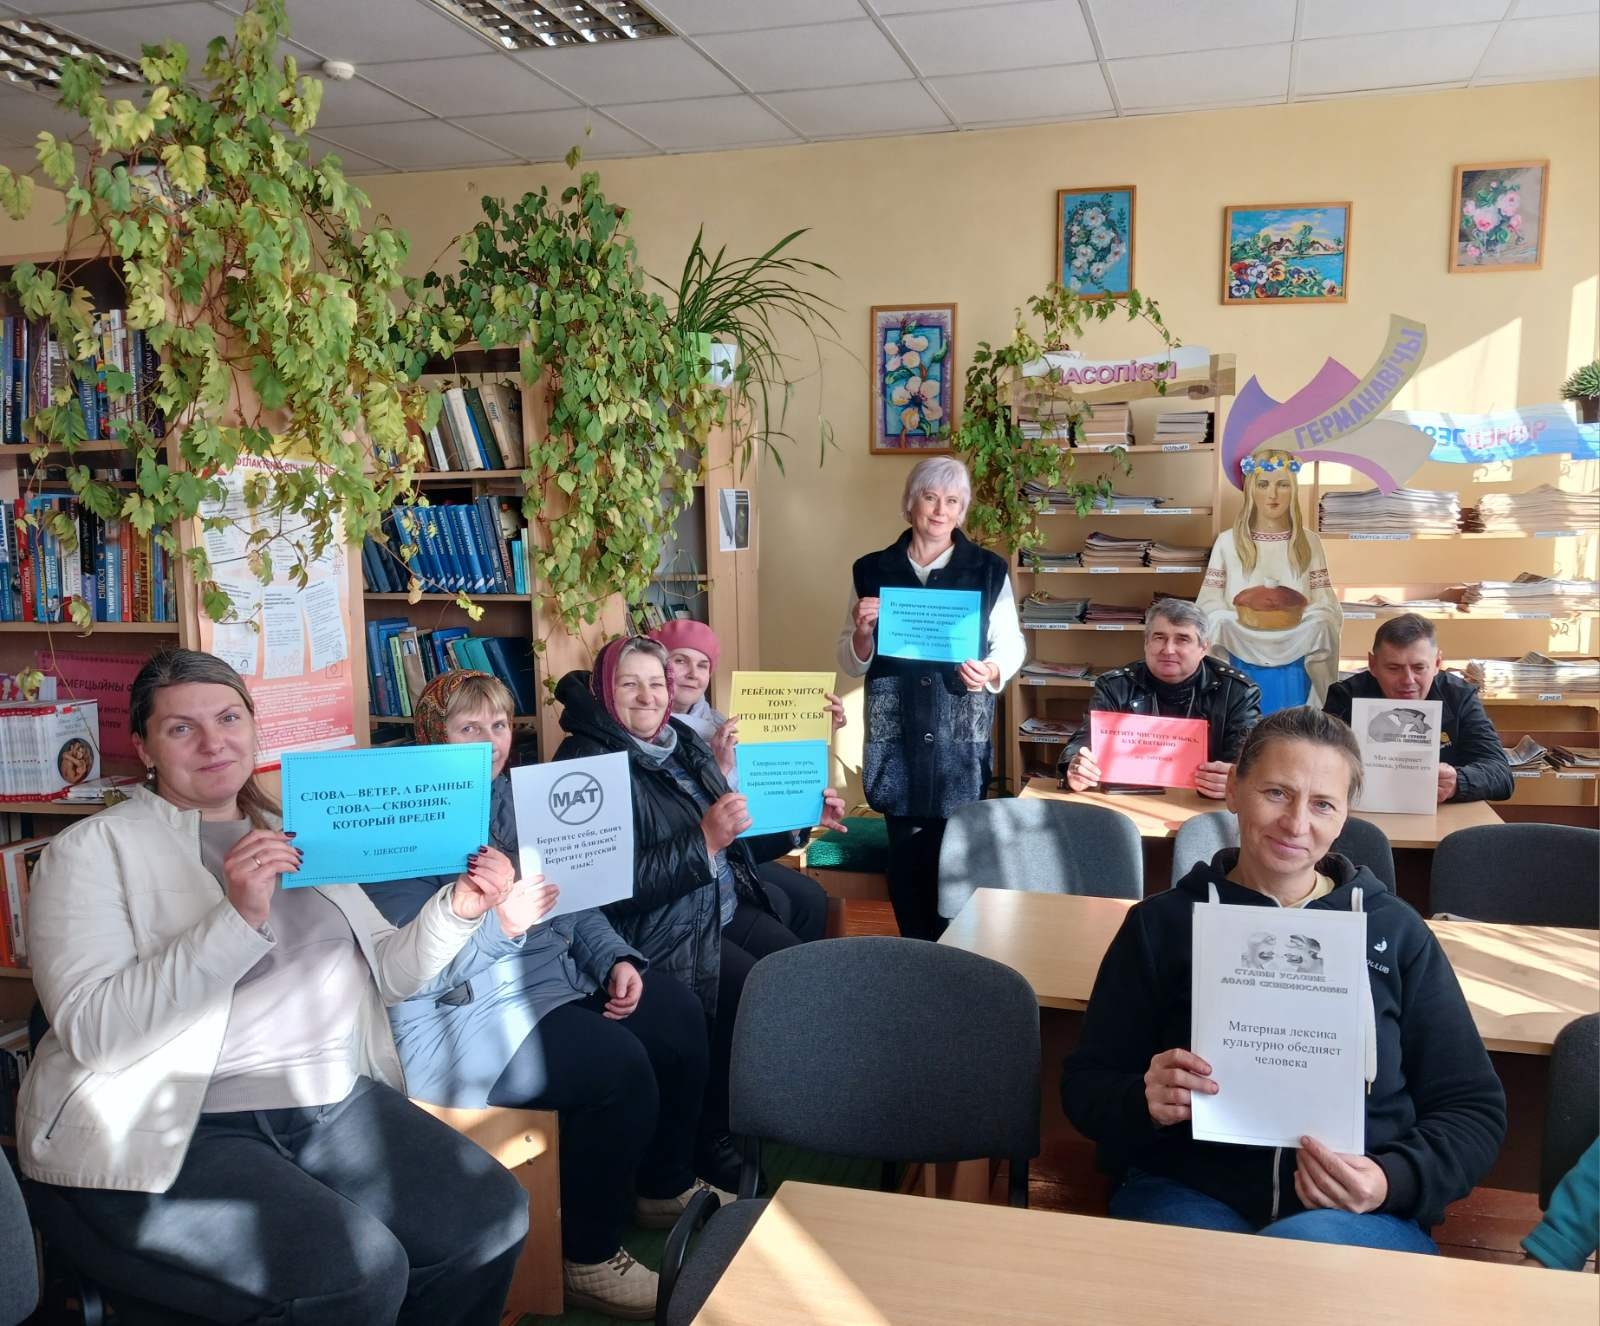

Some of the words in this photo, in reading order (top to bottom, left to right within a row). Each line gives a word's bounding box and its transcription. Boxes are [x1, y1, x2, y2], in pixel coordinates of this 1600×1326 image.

[1294, 327, 1425, 449] ГЕРМАНАВІЧЫ
[57, 679, 124, 692] АМЕРЦЫЙНЫ
[741, 686, 784, 696] РЕБЁНОК
[787, 687, 824, 696] УЧИТСЯ
[758, 712, 788, 721] ВИДИТ
[800, 712, 824, 720] СЕБЯ
[763, 724, 769, 732] В
[771, 724, 797, 733] ДОМУ
[405, 786, 412, 795] А
[415, 780, 474, 794] БРАННЫЕ
[553, 788, 598, 808] МАТ
[332, 815, 395, 830] КОТОРЫЙ
[399, 811, 445, 825] ВРЕДЕН
[536, 832, 576, 845] Берегите
[599, 825, 622, 835] своих
[373, 845, 418, 856] ШЕКСПИР
[543, 843, 573, 855] друзей
[545, 854, 583, 865] Берегите
[585, 845, 617, 860] русский
[1228, 1020, 1287, 1036] Матерная
[1289, 1028, 1337, 1040] лексика
[1222, 1038, 1285, 1053] культурно
[1287, 1043, 1342, 1057] обедняет
[1255, 1056, 1308, 1069] человека
